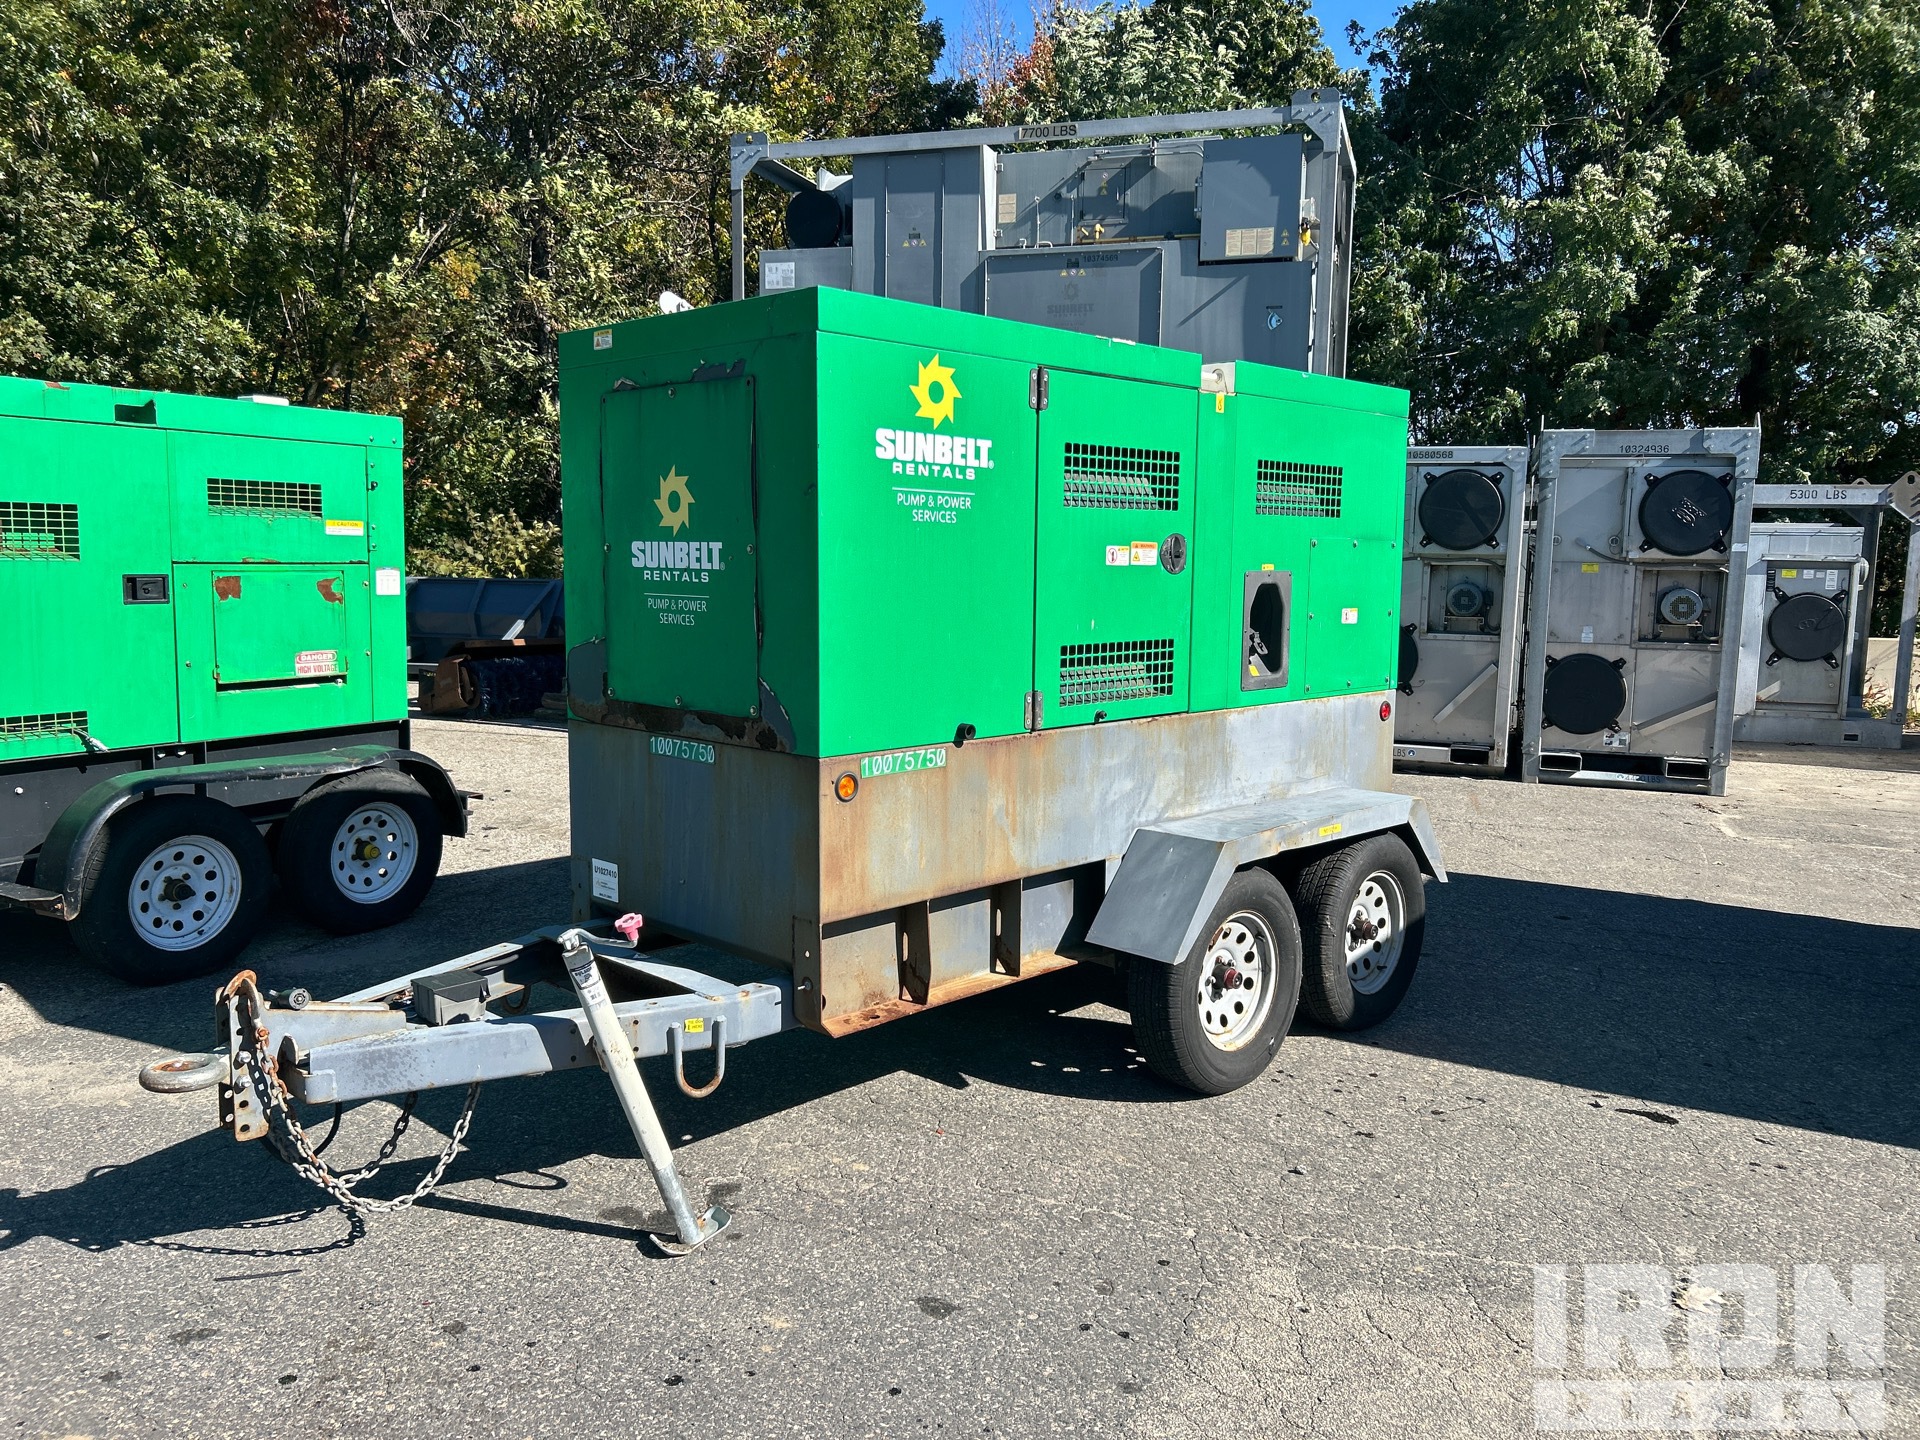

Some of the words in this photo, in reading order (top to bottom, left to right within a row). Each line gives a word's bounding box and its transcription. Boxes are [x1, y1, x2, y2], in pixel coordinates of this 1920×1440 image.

[1021, 126, 1050, 139] 7700
[1053, 124, 1077, 137] LBS
[875, 427, 993, 469] SUNBELT
[1408, 450, 1454, 459] 10580568
[1619, 444, 1670, 454] 10324936
[892, 462, 976, 480] RENTALS
[897, 492, 926, 507] PUMP
[927, 495, 935, 507] &
[937, 495, 972, 510] POWER
[1790, 489, 1818, 500] 5300
[1825, 489, 1847, 500] LBS
[912, 509, 957, 524] SERVICES
[631, 541, 723, 570] SUNBELT
[643, 570, 709, 583] RENTALS
[647, 598, 670, 610] PUMP
[671, 599, 677, 611] &
[678, 599, 707, 612] POWER
[659, 612, 695, 626] SERVICES
[301, 653, 333, 661] DANGER
[297, 665, 311, 674] HIGH
[313, 663, 337, 673] VOLTAGE
[650, 736, 715, 763] 10075750
[1393, 748, 1406, 758] LBS
[861, 747, 947, 776] 10075750
